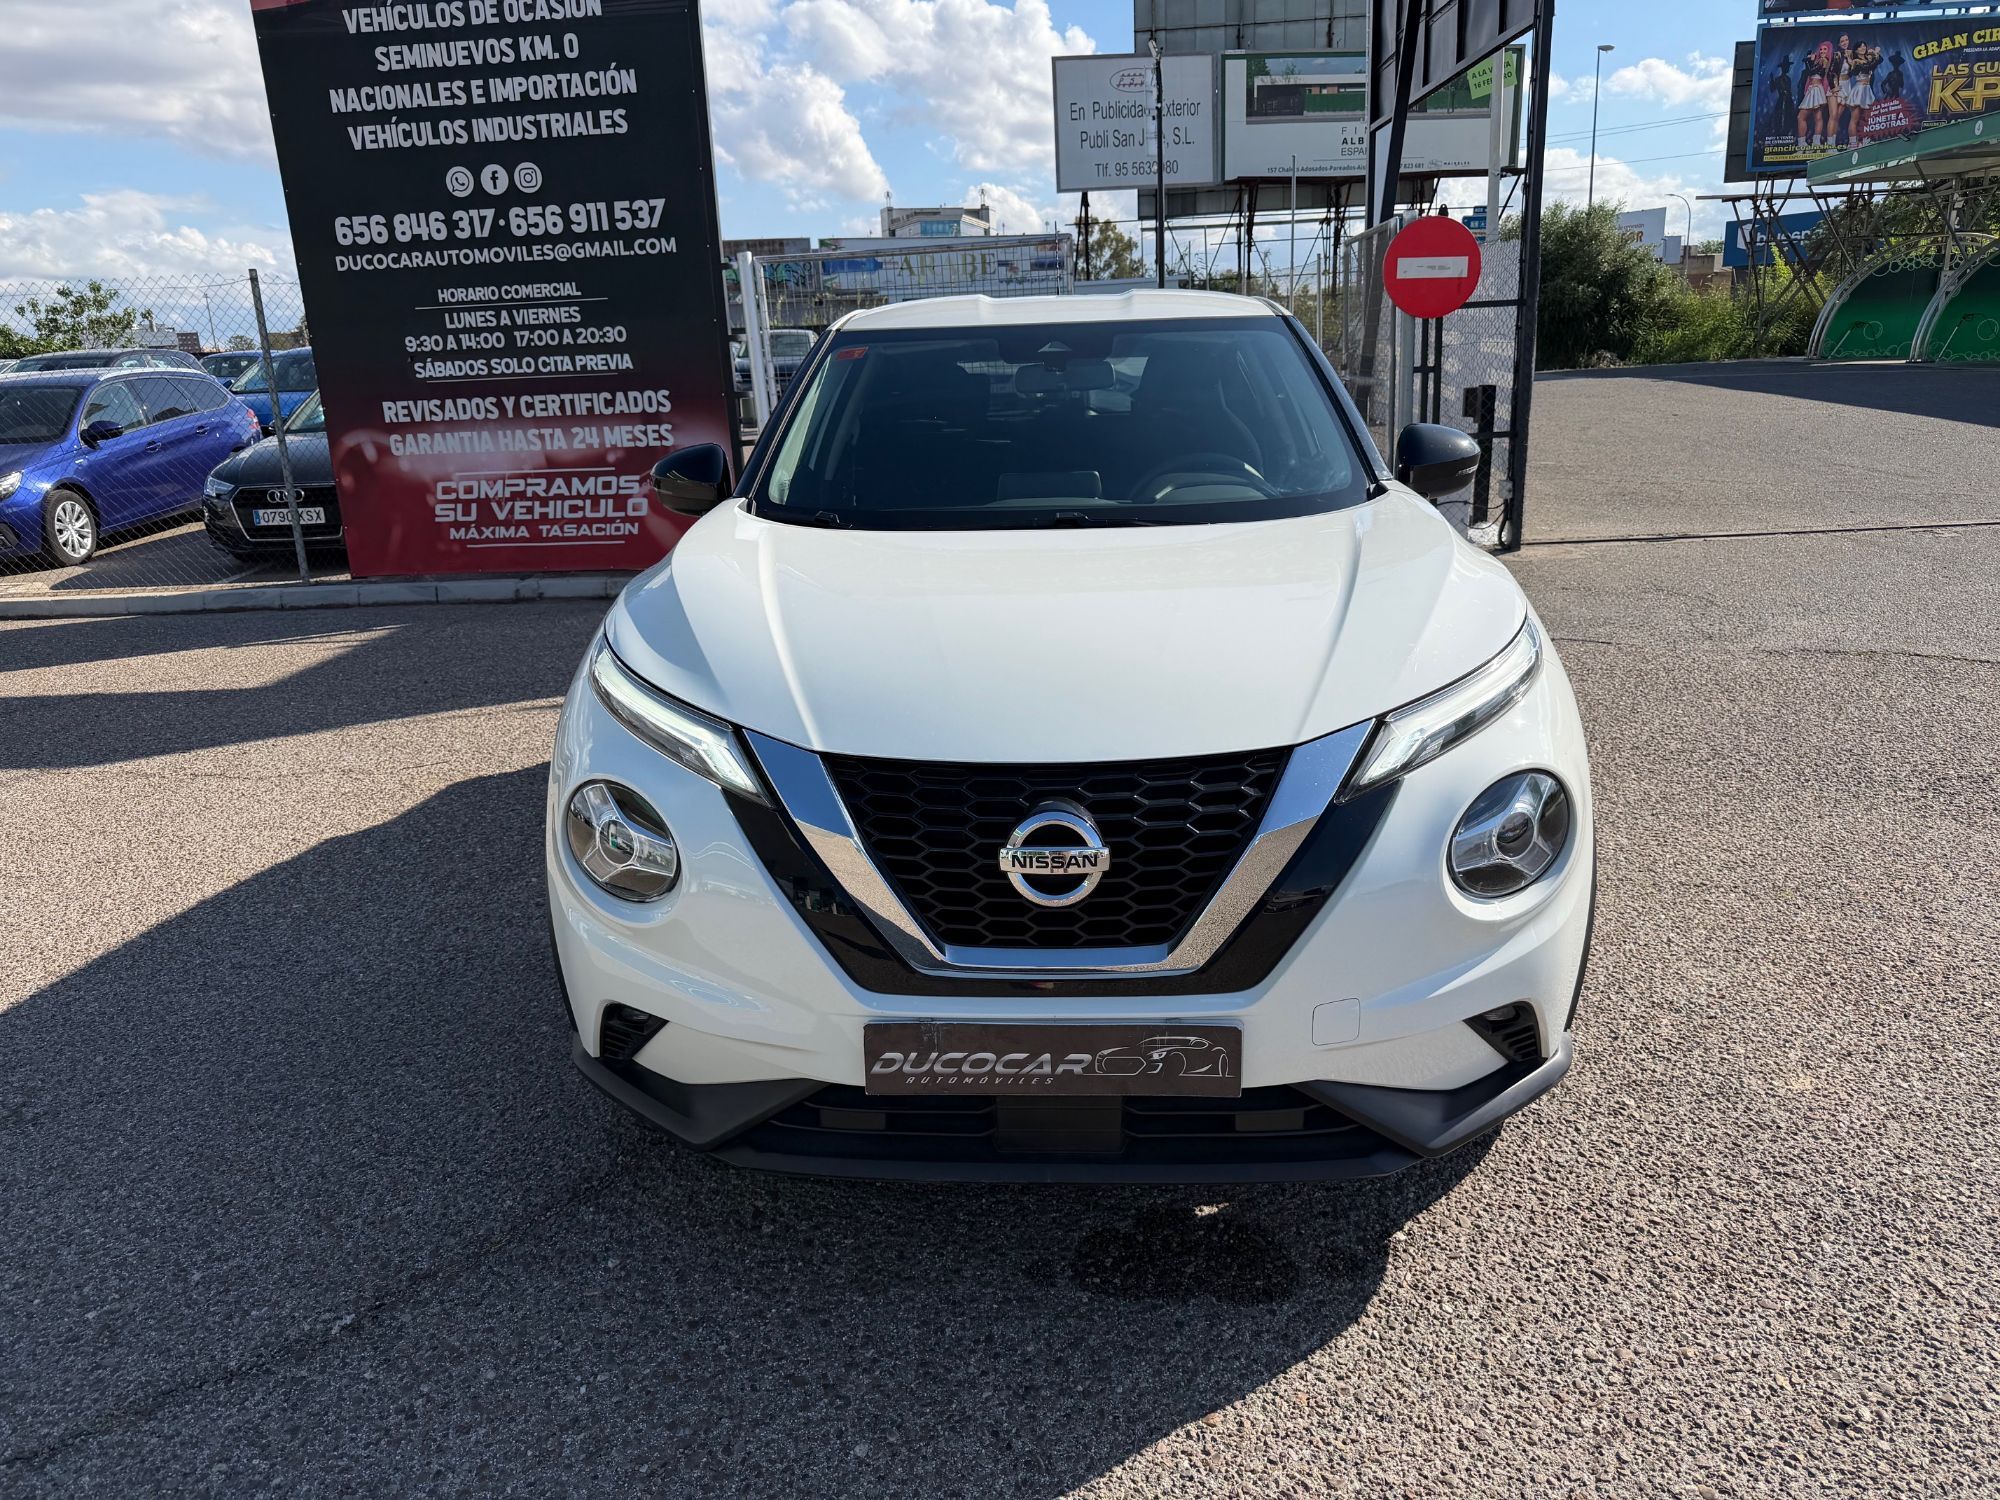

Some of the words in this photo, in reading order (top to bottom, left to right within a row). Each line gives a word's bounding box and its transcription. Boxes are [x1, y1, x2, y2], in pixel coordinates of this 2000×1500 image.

[342, 0, 465, 34] VEHÍCULOS
[469, 0, 500, 25] DE
[375, 37, 515, 72] SEMINUEVOS
[519, 35, 559, 62] KM.
[1913, 33, 1968, 59] GRAN
[1933, 63, 1969, 77] LAS
[1973, 61, 2000, 74] GU
[329, 80, 467, 113] NACIONALES
[470, 80, 486, 104] E
[488, 62, 637, 103] IMPORTACIÓN
[1473, 81, 1482, 89] 16
[1070, 102, 1086, 121] En
[1162, 97, 1201, 118] xterior
[347, 116, 468, 150] VEHÍCULOS
[472, 109, 628, 143] INDUSTRIALES
[1863, 117, 1909, 133] NOSOTRAS!
[1080, 130, 1109, 149] Publi
[1112, 129, 1135, 148] San
[1173, 126, 1195, 145] S.L.
[1341, 137, 1365, 146] ALB
[1095, 163, 1111, 178] Tlf.
[1115, 162, 1128, 177] 95
[335, 213, 389, 246] 656
[393, 211, 448, 243] 846
[452, 208, 496, 239] 317
[508, 205, 564, 237] 656
[569, 202, 610, 233] 911
[614, 198, 666, 231] 537
[335, 237, 677, 272] DUCOCARAUTOMOVILES@GMAIL.COM
[438, 285, 499, 303] HORARIO
[501, 281, 582, 300] COMERCIAL
[445, 310, 497, 329] LUNES
[500, 309, 511, 326] A
[512, 306, 581, 325] VIERNES
[405, 335, 443, 353] 9:30
[447, 334, 458, 350] A
[459, 332, 505, 350] 14:00
[514, 329, 559, 347] 17:00
[563, 328, 574, 345] A
[575, 325, 627, 344] 20:30
[414, 358, 488, 378] SÁBADOS
[491, 356, 535, 374] SOLO
[538, 355, 573, 373] CITA
[575, 353, 634, 371] PREVIA
[382, 396, 499, 423] REVISADOS
[501, 395, 516, 418] Y
[519, 389, 672, 417] CERTIFICADOS
[389, 431, 493, 456] GARANTIA
[498, 427, 568, 451] HASTA
[571, 426, 600, 449] 24
[603, 423, 675, 449] MESES
[436, 475, 640, 500] COMPRAMOS
[434, 502, 477, 522] SU
[491, 497, 649, 520] VEHICULO
[450, 523, 530, 540] MÁXIMA
[539, 519, 639, 537] TASACIÓN
[1011, 854, 1098, 869] NISSAN
[870, 1052, 1094, 1075] DUCOCAR
[905, 1074, 1054, 1085] AUTOMÓVILES
